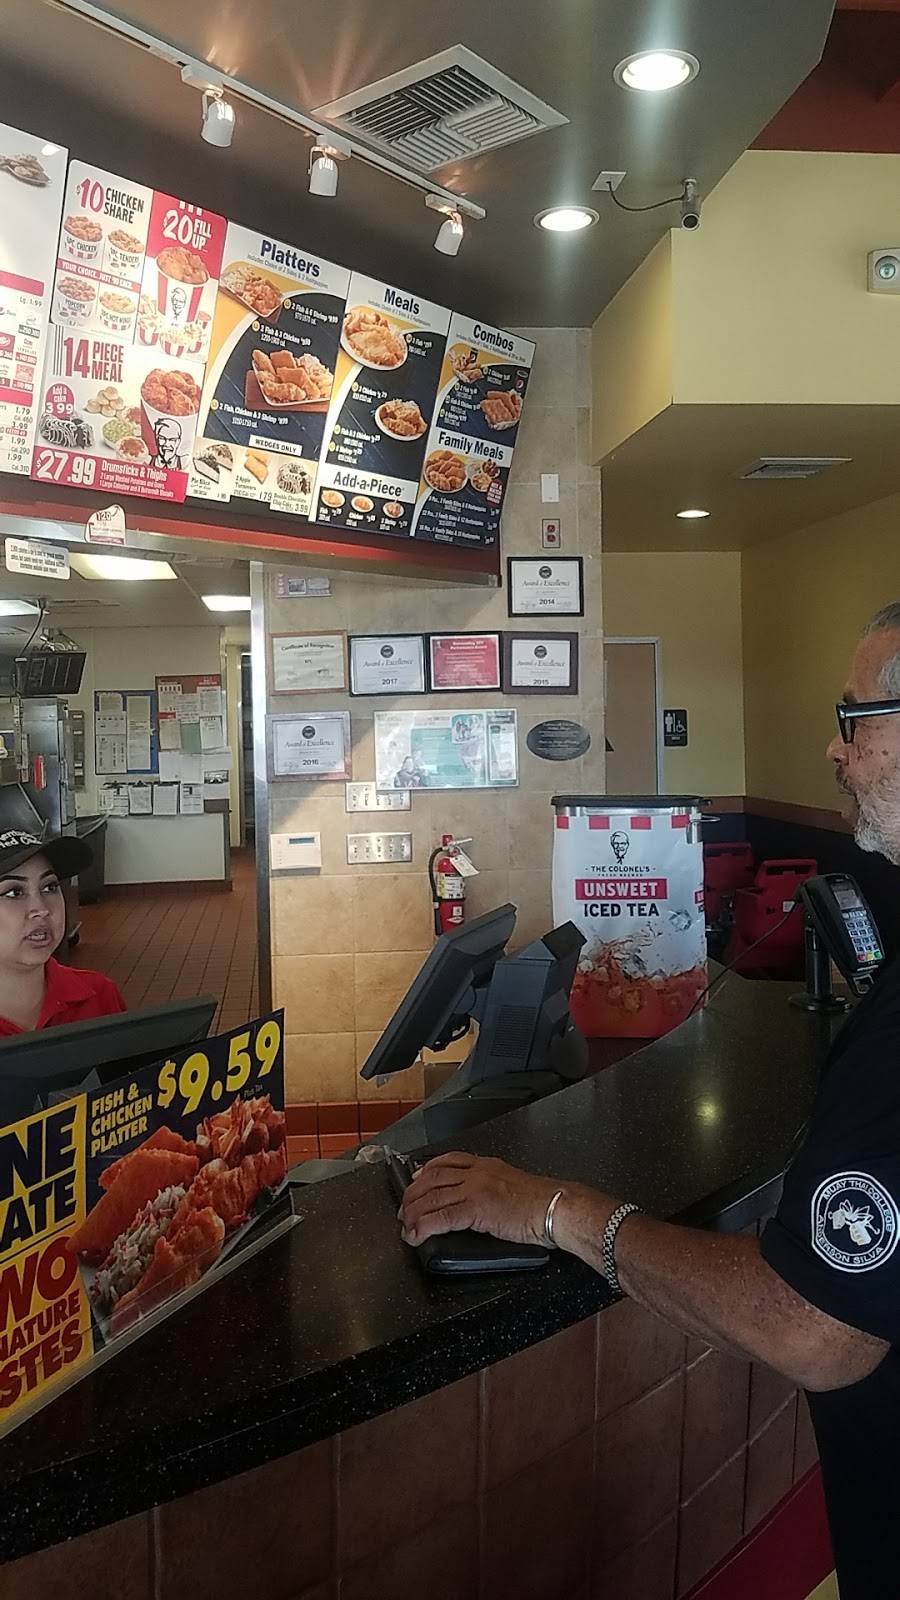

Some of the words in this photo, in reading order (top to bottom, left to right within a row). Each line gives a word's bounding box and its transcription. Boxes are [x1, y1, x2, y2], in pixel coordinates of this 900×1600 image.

[76, 177, 105, 213] $10
[105, 187, 145, 213] CHICKEN
[104, 202, 134, 224] SHARE
[163, 209, 193, 244] $20
[194, 218, 211, 237] FILL
[77, 242, 97, 251] CHICKEN
[192, 234, 207, 250] UP
[260, 239, 321, 277] Platters
[62, 262, 77, 271] YOUR
[100, 273, 111, 282] JUST
[65, 298, 85, 309] POPCORN
[384, 288, 420, 315] Meals
[296, 304, 305, 313] Fish
[313, 310, 327, 322] Shrimp
[260, 324, 264, 332] 2
[265, 326, 274, 335] Fish
[275, 329, 279, 337] &
[283, 332, 300, 344] Chicken
[473, 324, 514, 351] Combos
[64, 337, 90, 379] 14
[92, 341, 124, 363] PIECE
[91, 359, 123, 383] MEAL
[16, 407, 30, 415] 1.79
[219, 402, 223, 410] 2
[235, 407, 253, 417] Chicken
[261, 413, 277, 424] Shrimp
[12, 421, 28, 430] 3.99
[11, 436, 26, 445] 1.99
[20, 447, 30, 455] 290
[255, 439, 280, 449] WEDGES
[281, 445, 297, 453] ONLY
[438, 431, 474, 454] Family
[474, 440, 504, 460] Meals
[7, 453, 22, 461] 1.99
[36, 450, 96, 485] $27.99
[102, 460, 139, 477] Drumsticks
[140, 467, 145, 478] &
[147, 468, 167, 482] Thighs
[104, 473, 115, 481] Large
[130, 478, 146, 486] Potatoes
[102, 480, 113, 488] Large
[584, 882, 658, 896] UNSWEET
[584, 903, 621, 917] ICED
[627, 903, 659, 917] TEA
[158, 1020, 281, 1117] $9.59
[91, 1088, 124, 1118] FISH
[127, 1082, 139, 1101] &
[91, 1094, 153, 1136] CHICKEN
[90, 1116, 149, 1158] PLATTER
[822, 1180, 847, 1200] MUAY
[848, 1181, 868, 1191] THAI
[818, 1214, 850, 1263] ANDERSON
[853, 1247, 884, 1265] SILVA
[0, 1319, 83, 1408] STES
